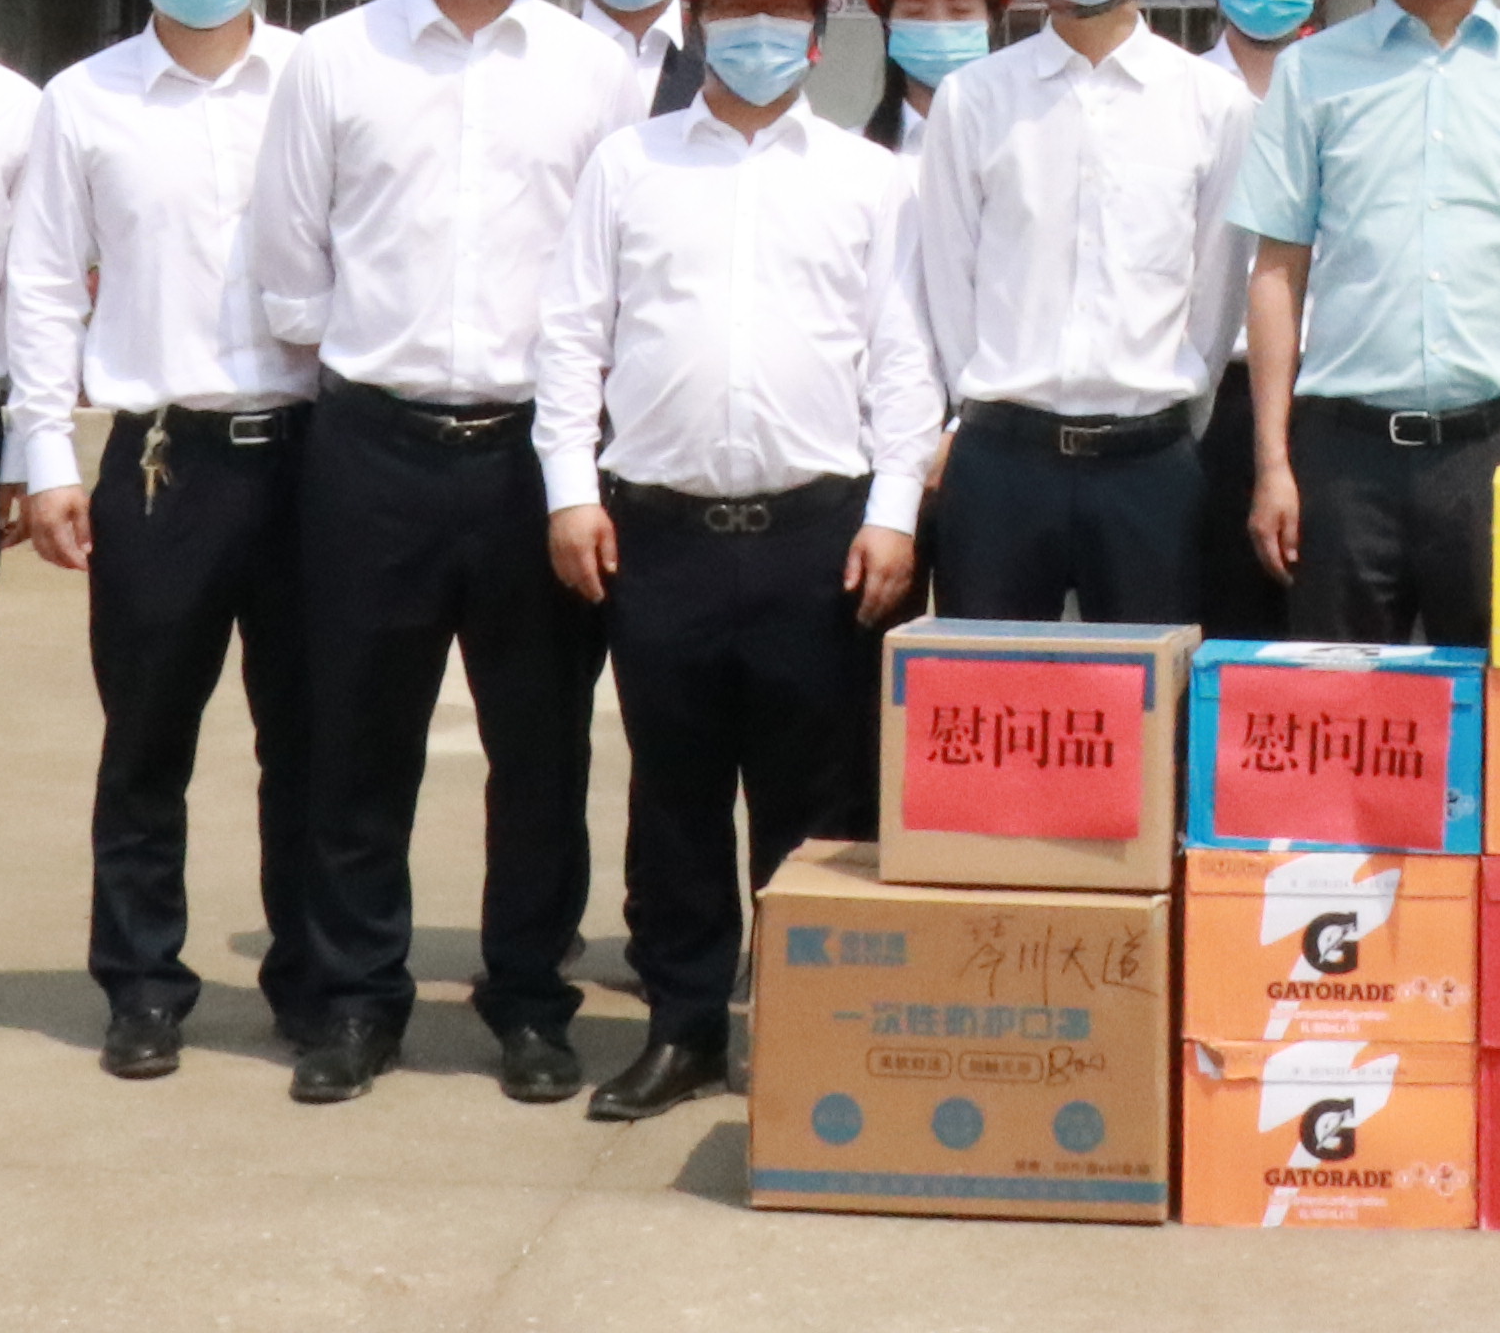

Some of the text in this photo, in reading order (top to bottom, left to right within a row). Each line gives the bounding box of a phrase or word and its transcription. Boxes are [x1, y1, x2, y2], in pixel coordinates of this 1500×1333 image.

[927, 704, 1115, 769] 慰问品
[1241, 711, 1424, 779] 慰问品
[1302, 911, 1359, 975] G
[833, 1001, 1091, 1040] 一次性防护口罩
[1266, 980, 1395, 1004] GATORADE
[1300, 1098, 1356, 1161] G
[1263, 1168, 1393, 1189] GATORADE
